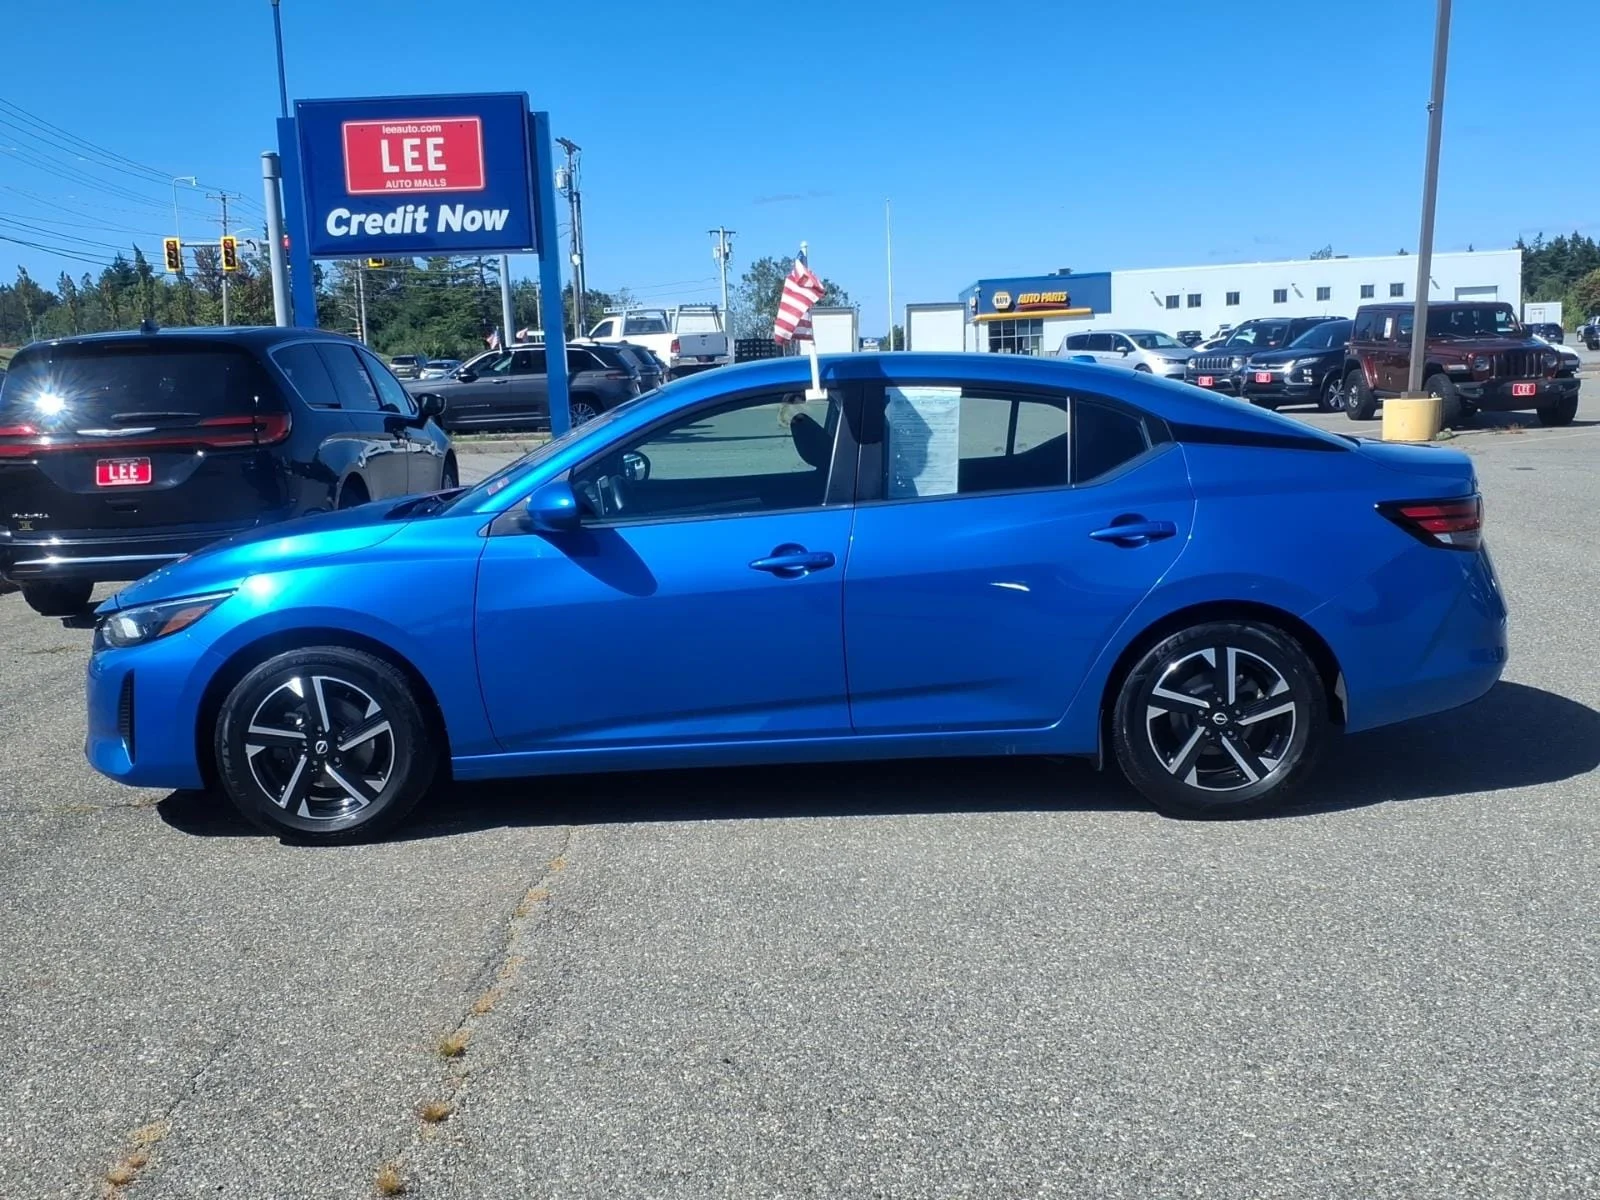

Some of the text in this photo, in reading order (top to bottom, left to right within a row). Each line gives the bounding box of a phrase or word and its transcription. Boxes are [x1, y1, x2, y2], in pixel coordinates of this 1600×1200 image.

[382, 124, 442, 135] leeauto.com
[380, 137, 447, 174] LEE
[385, 178, 447, 189] AUTO MALLS
[326, 204, 510, 237] Credit Now
[1017, 291, 1067, 303] AUTO PARTS
[109, 462, 139, 479] LEE
